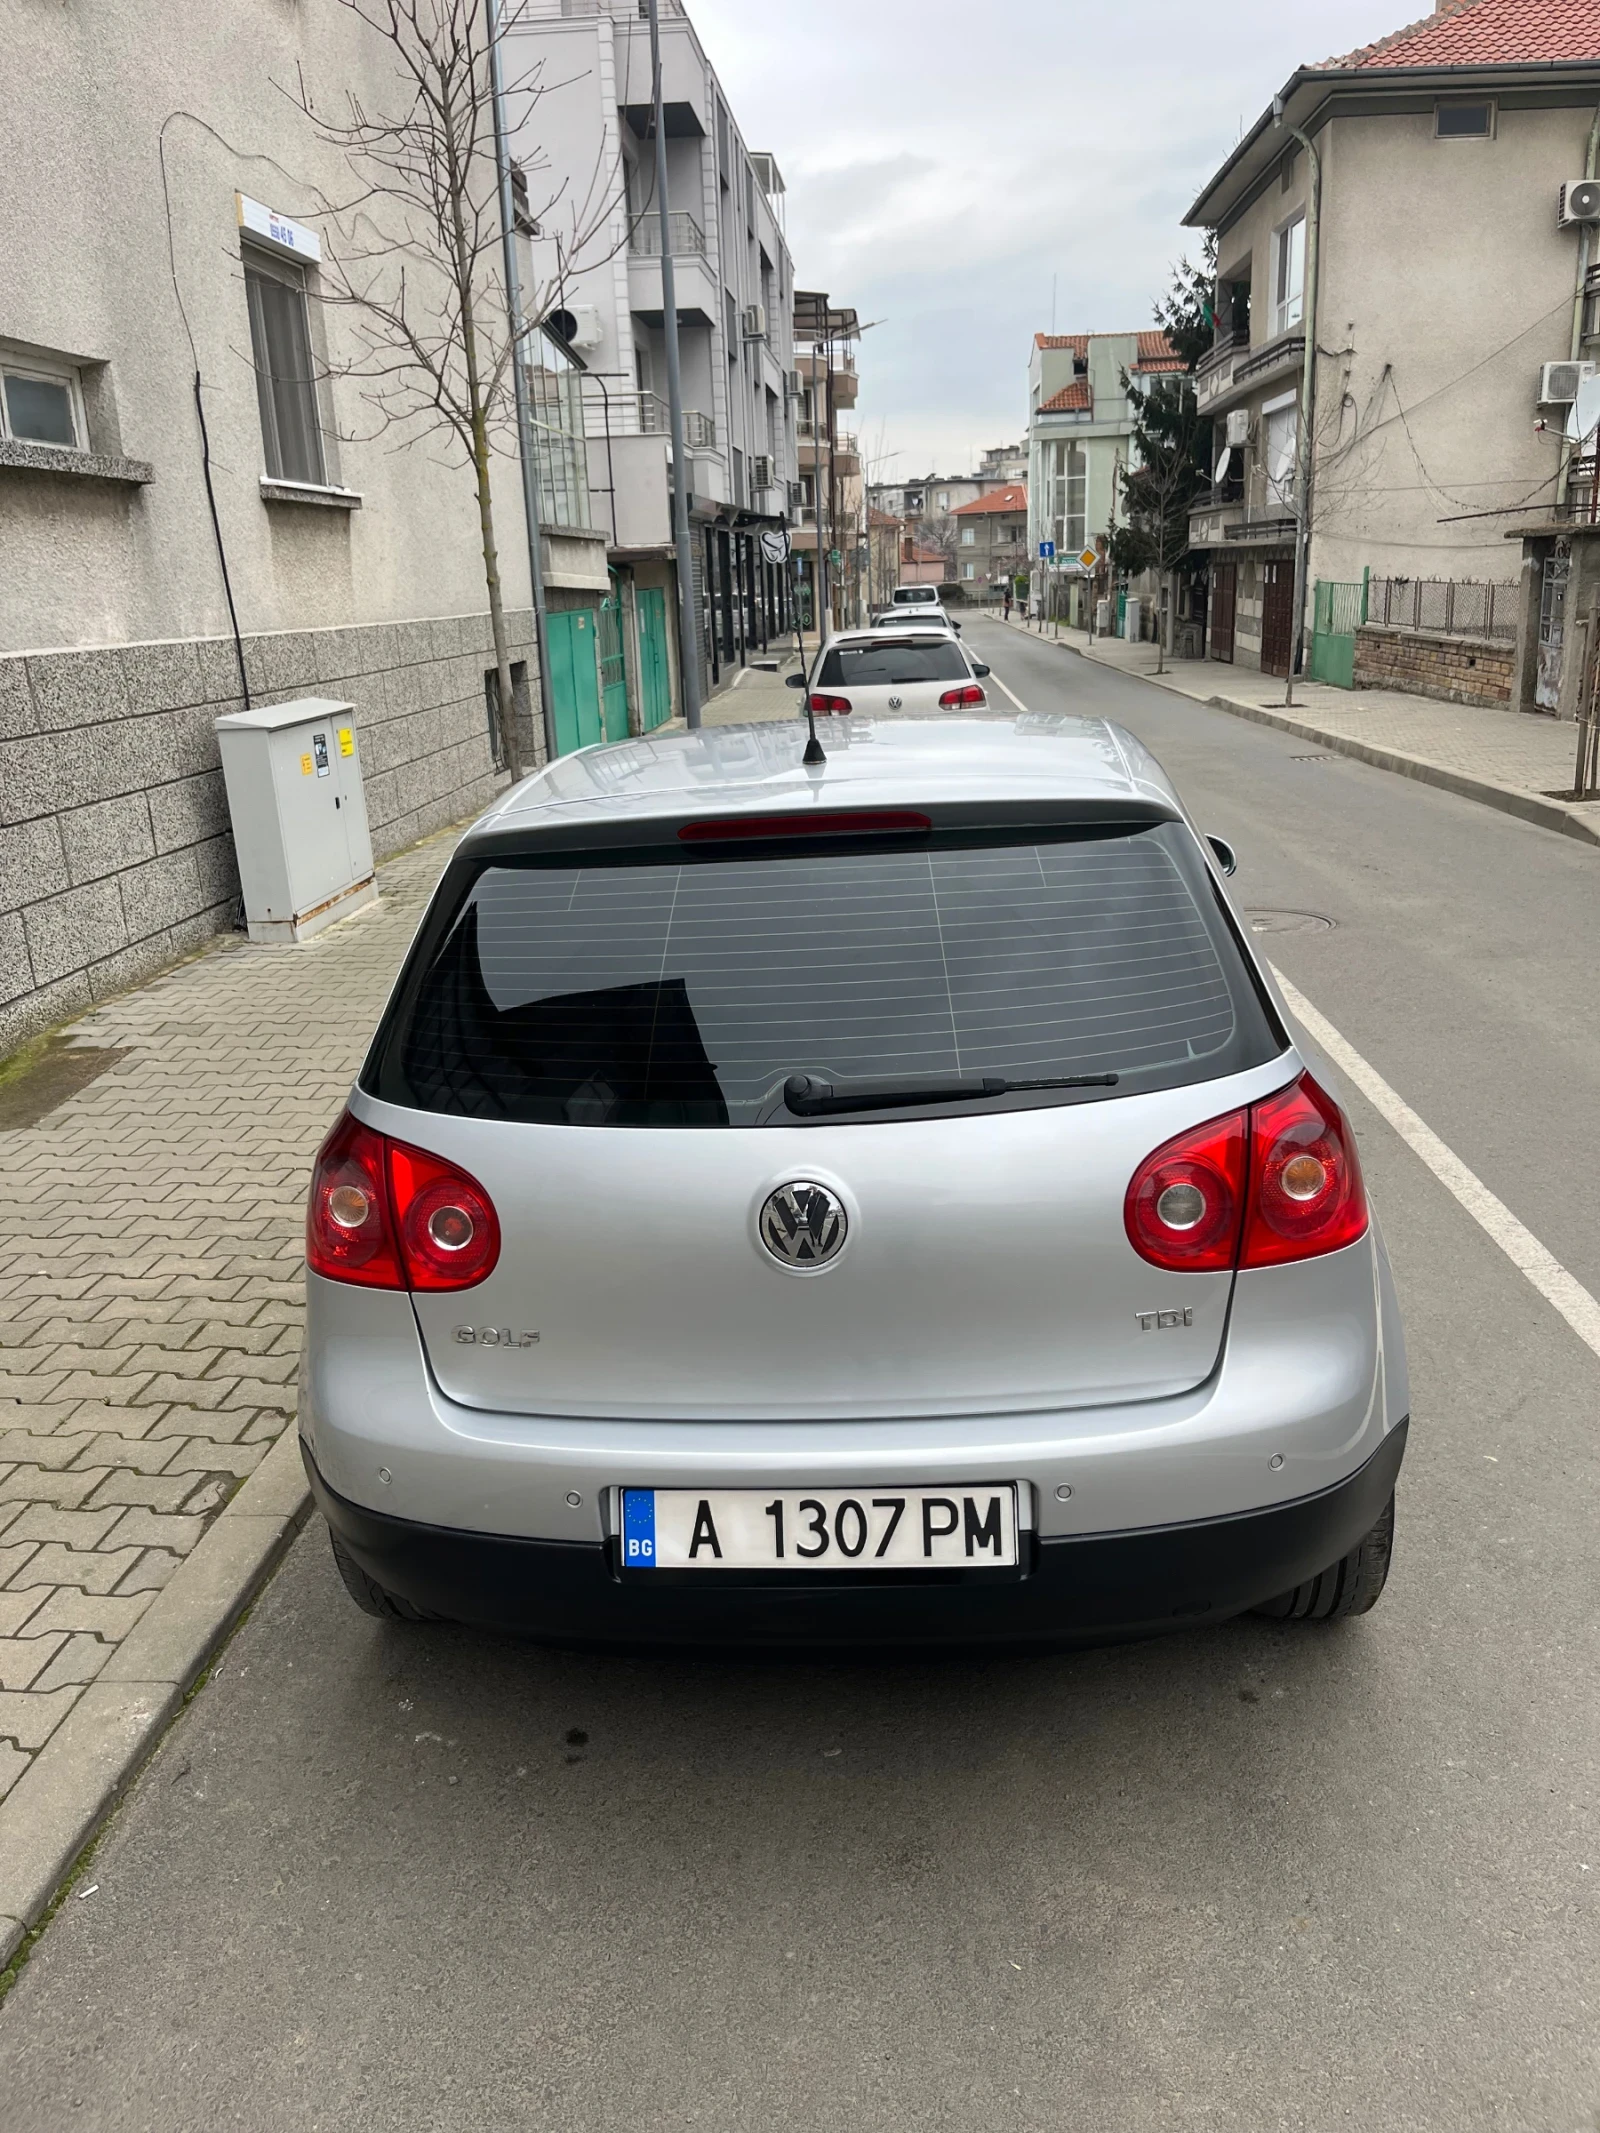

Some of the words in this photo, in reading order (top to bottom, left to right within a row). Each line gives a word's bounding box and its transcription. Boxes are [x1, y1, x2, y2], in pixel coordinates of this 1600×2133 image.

[759, 1180, 848, 1268] VW
[1135, 1306, 1193, 1332] TDI
[451, 1325, 540, 1349] GOLF
[688, 1500, 723, 1559] A
[765, 1498, 906, 1558] 1307
[922, 1496, 1002, 1558] PM
[628, 1539, 653, 1557] BG
